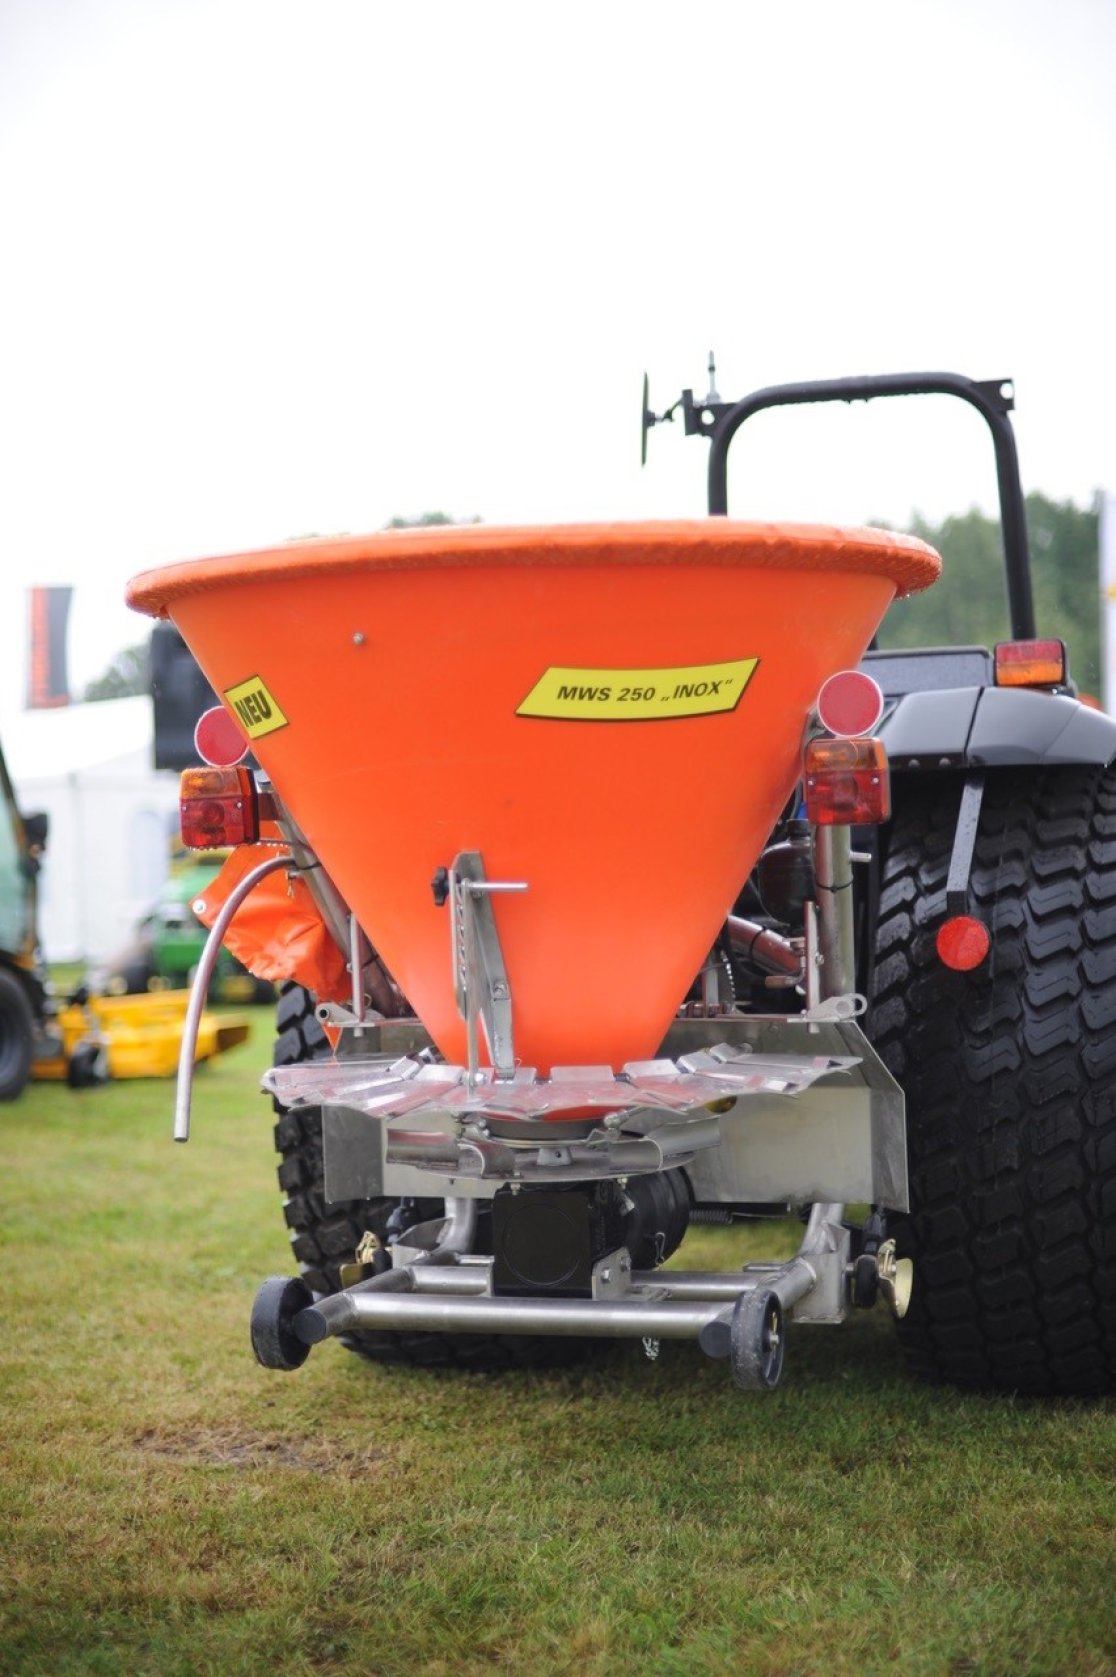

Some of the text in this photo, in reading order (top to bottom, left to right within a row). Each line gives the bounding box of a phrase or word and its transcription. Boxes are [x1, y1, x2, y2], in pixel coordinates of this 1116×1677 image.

[557, 686, 611, 702] MWS
[616, 688, 656, 702] 250
[235, 689, 273, 728] NEU
